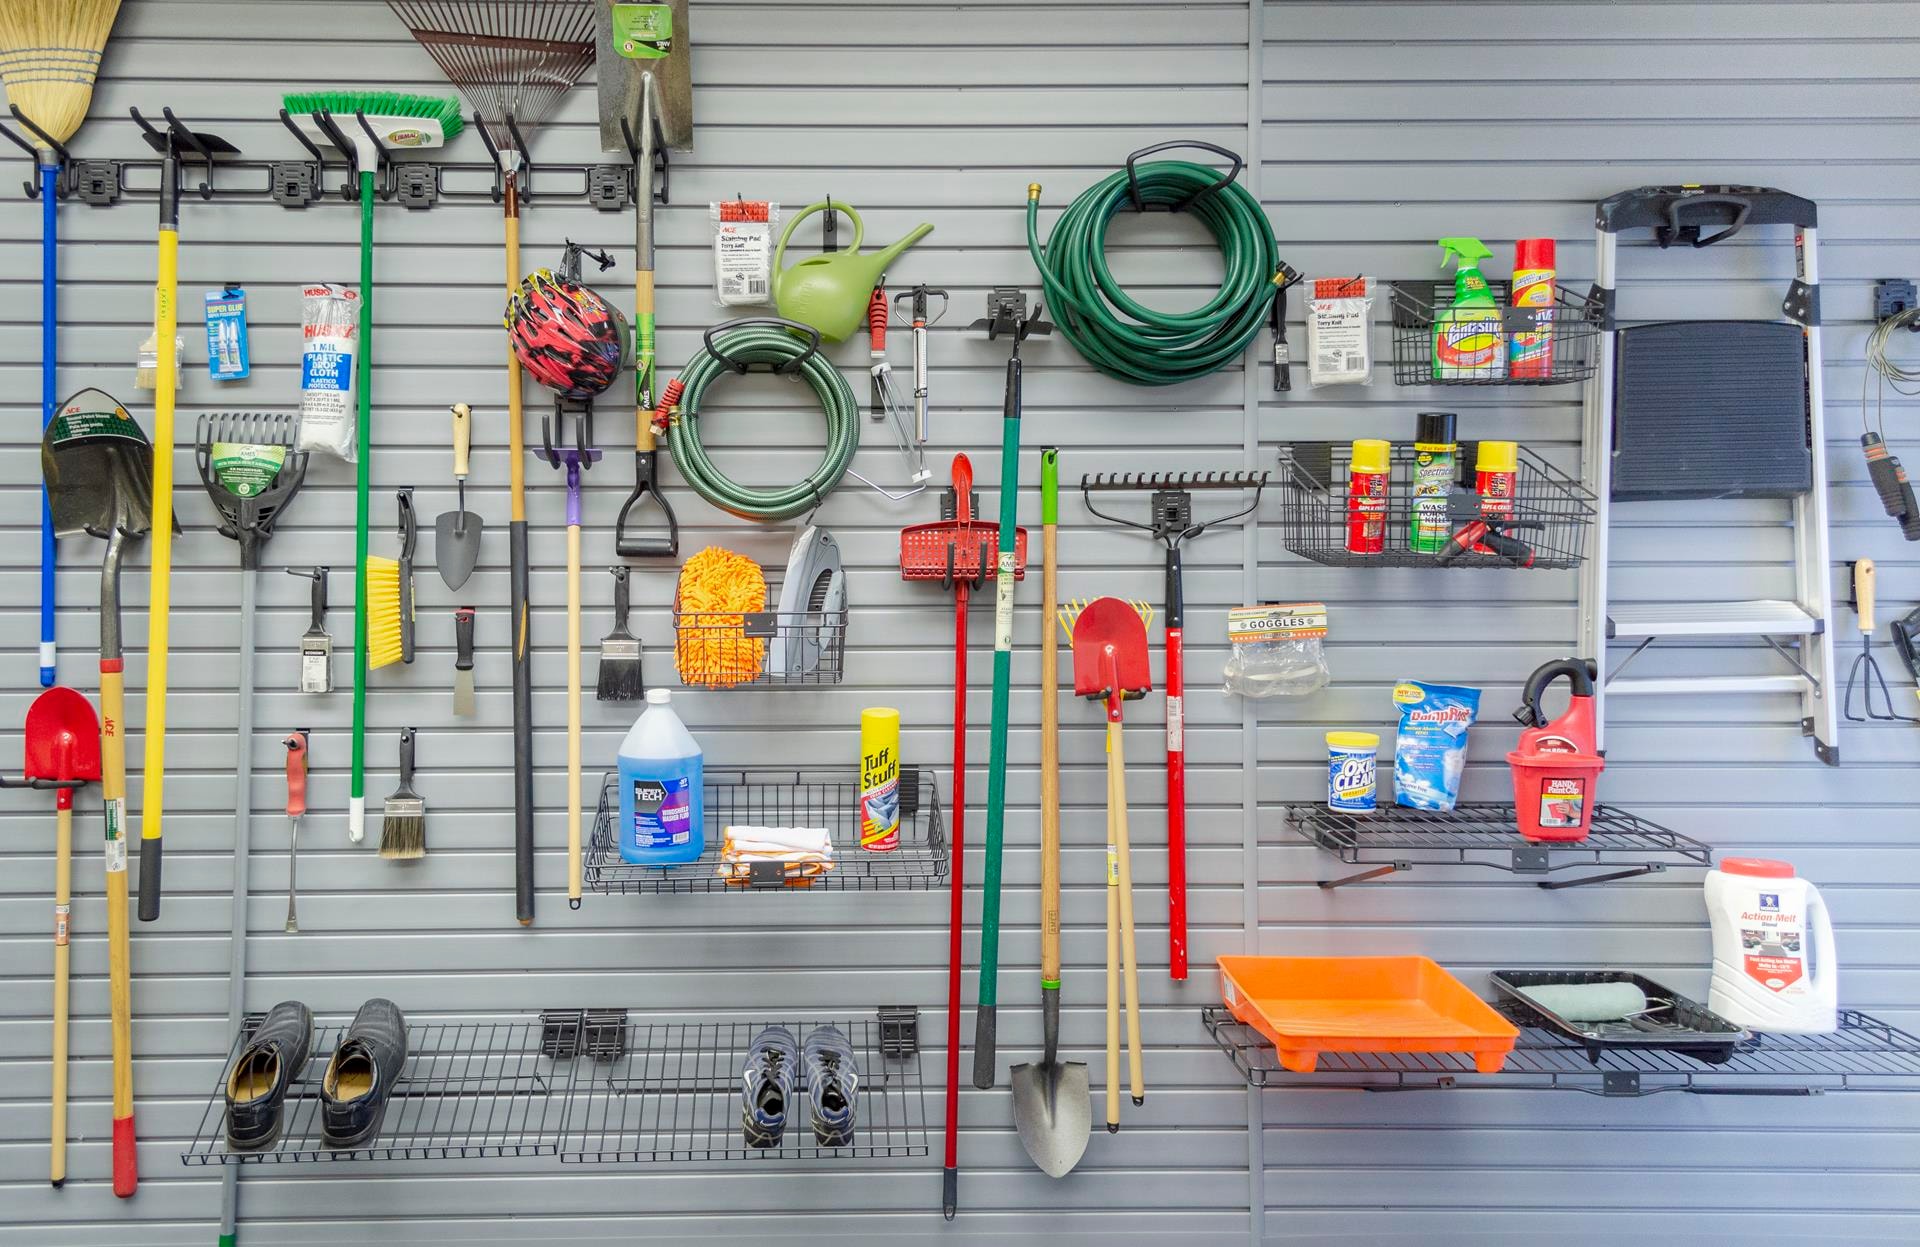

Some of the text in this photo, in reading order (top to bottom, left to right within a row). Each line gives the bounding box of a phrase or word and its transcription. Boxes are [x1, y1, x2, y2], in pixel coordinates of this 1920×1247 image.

[228, 303, 243, 311] GLUE
[1317, 303, 1333, 311] ACE
[320, 343, 337, 351] MIL
[307, 353, 344, 363] PLASTIC
[312, 361, 337, 369] DROP
[310, 369, 339, 377] CLOTH
[66, 407, 81, 415] ACE
[1249, 618, 1305, 629] GOGGLES
[104, 716, 115, 737] ACE
[864, 747, 889, 772] Tuff
[1344, 759, 1371, 777] OXI
[864, 760, 896, 790] Stuff
[1334, 770, 1376, 792] CLEAN
[1566, 787, 1579, 795] Cup
[637, 792, 662, 801] TECH
[1741, 911, 1796, 923] Action Melt
